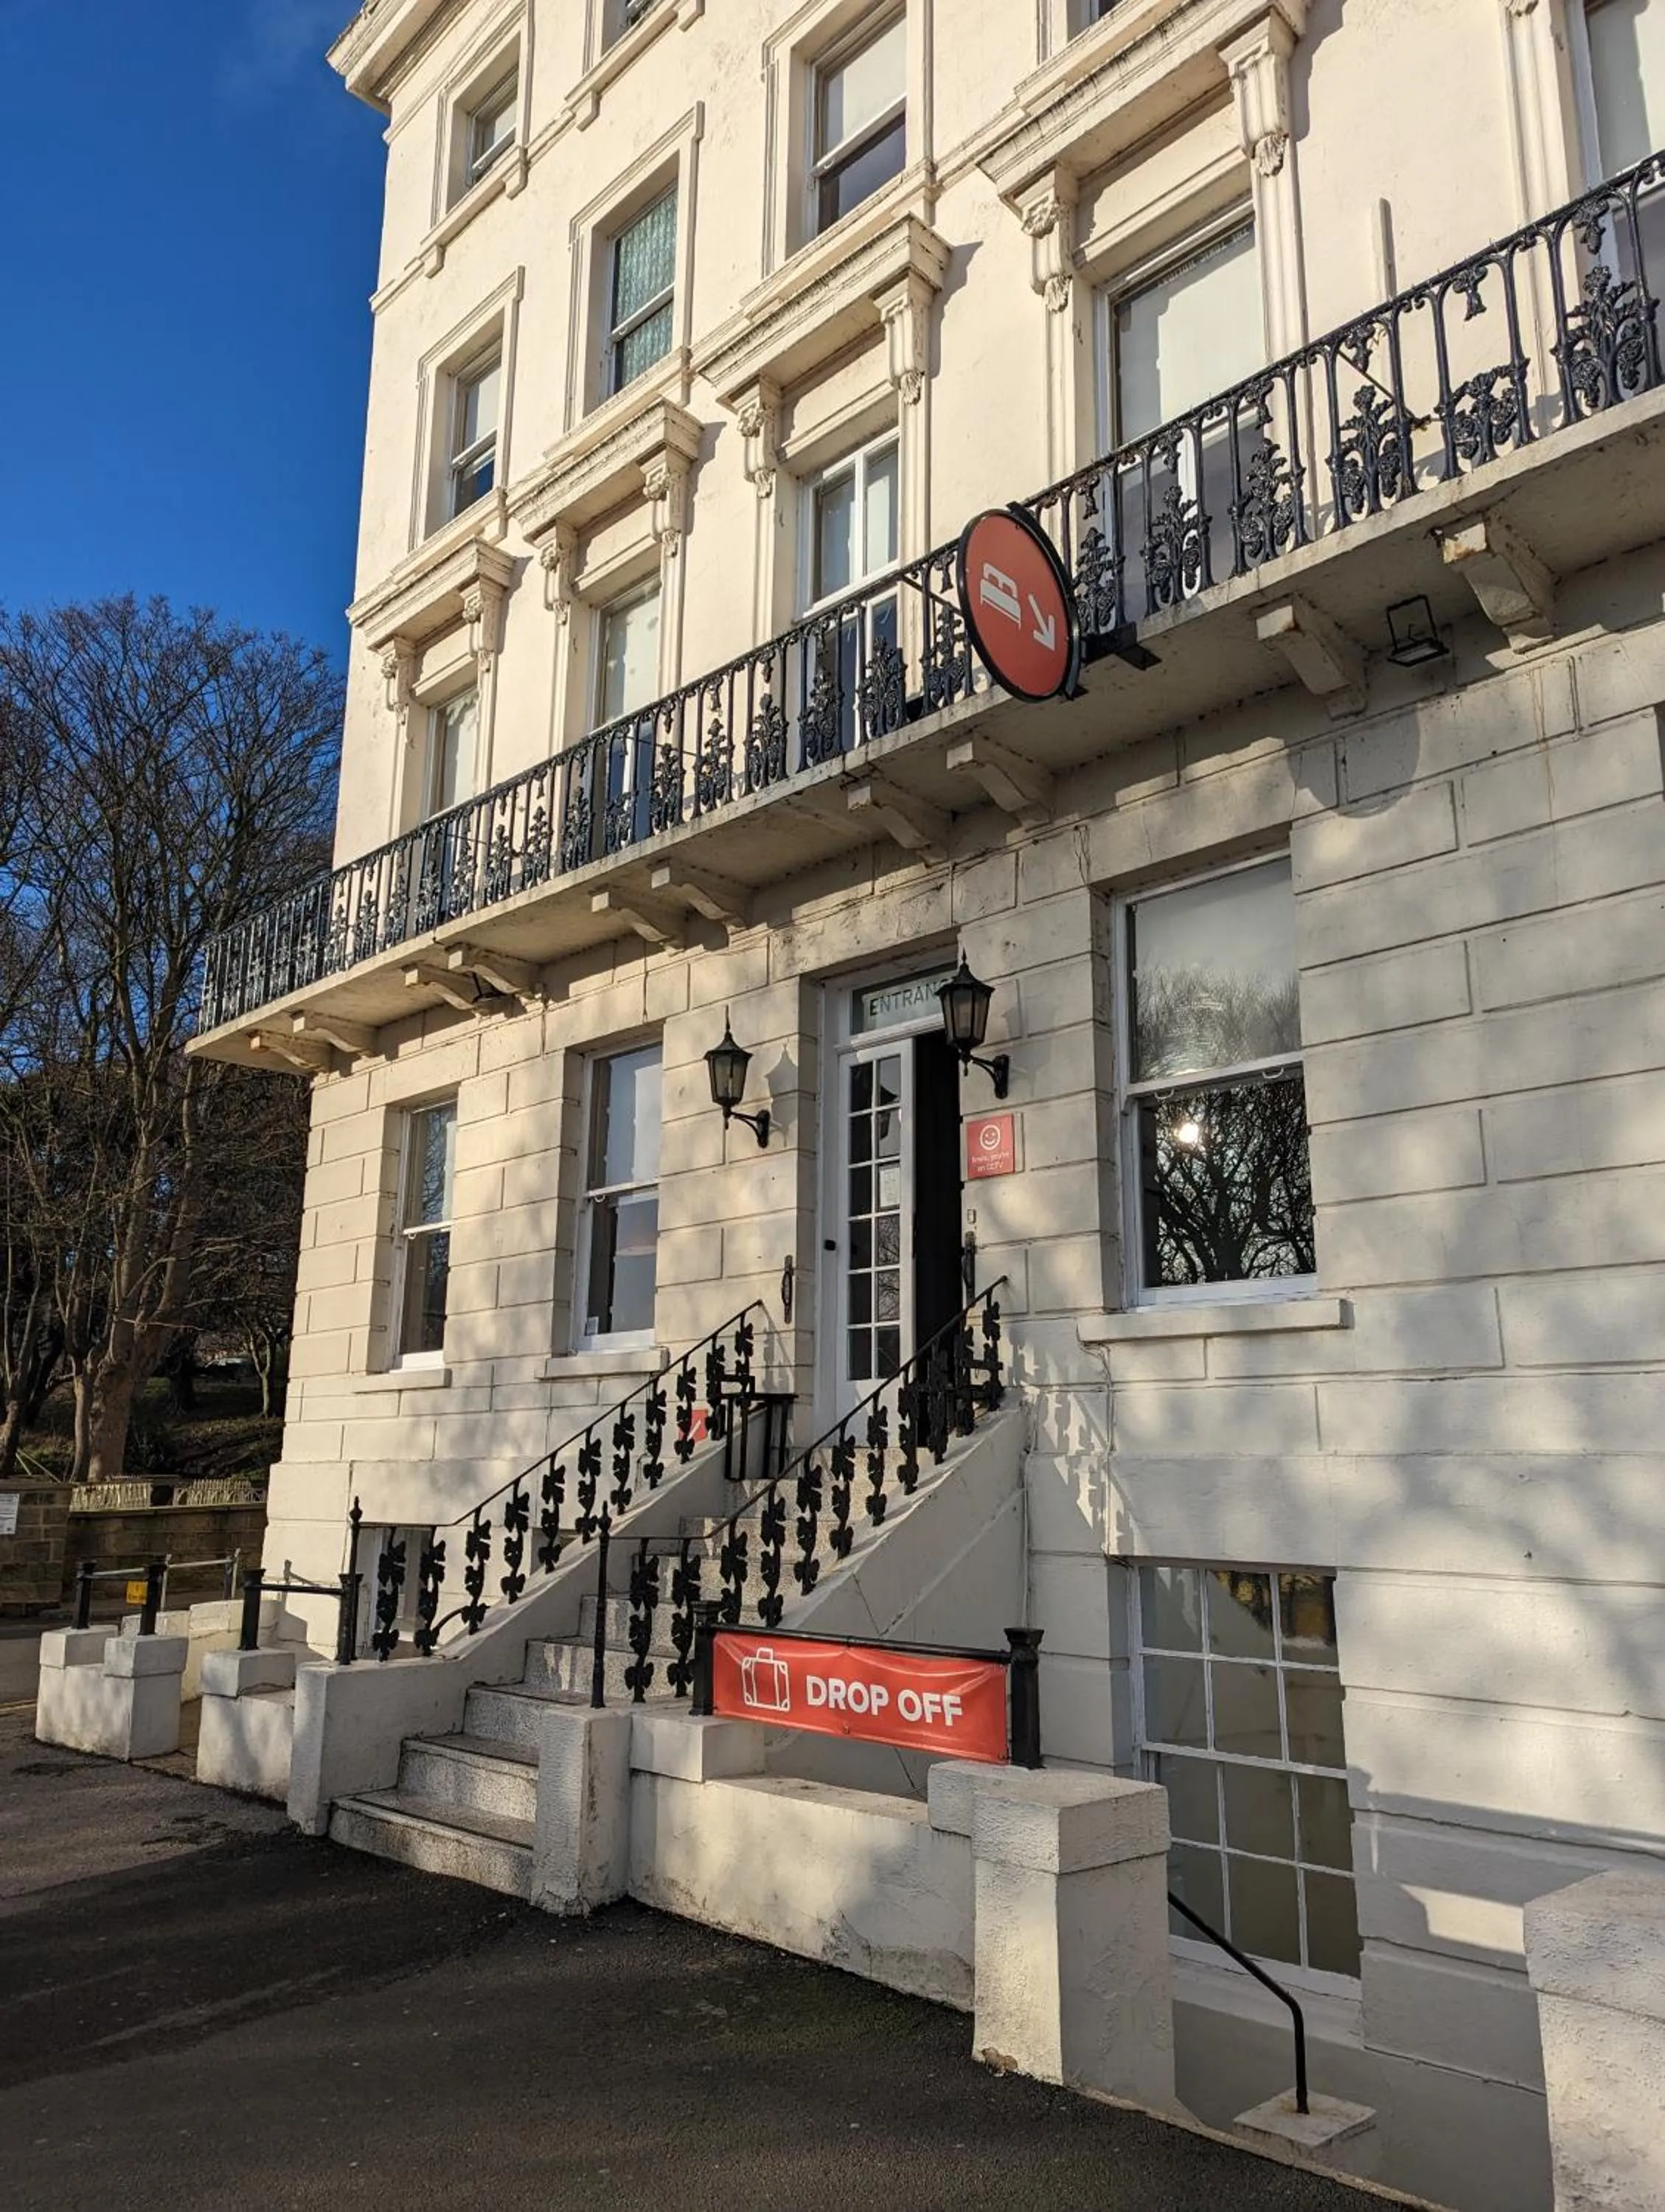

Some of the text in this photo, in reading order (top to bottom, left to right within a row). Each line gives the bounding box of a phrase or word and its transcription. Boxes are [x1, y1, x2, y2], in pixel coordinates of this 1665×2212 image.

[869, 978, 949, 1016] ENTRAN
[805, 1674, 963, 1727] DROP OFF
